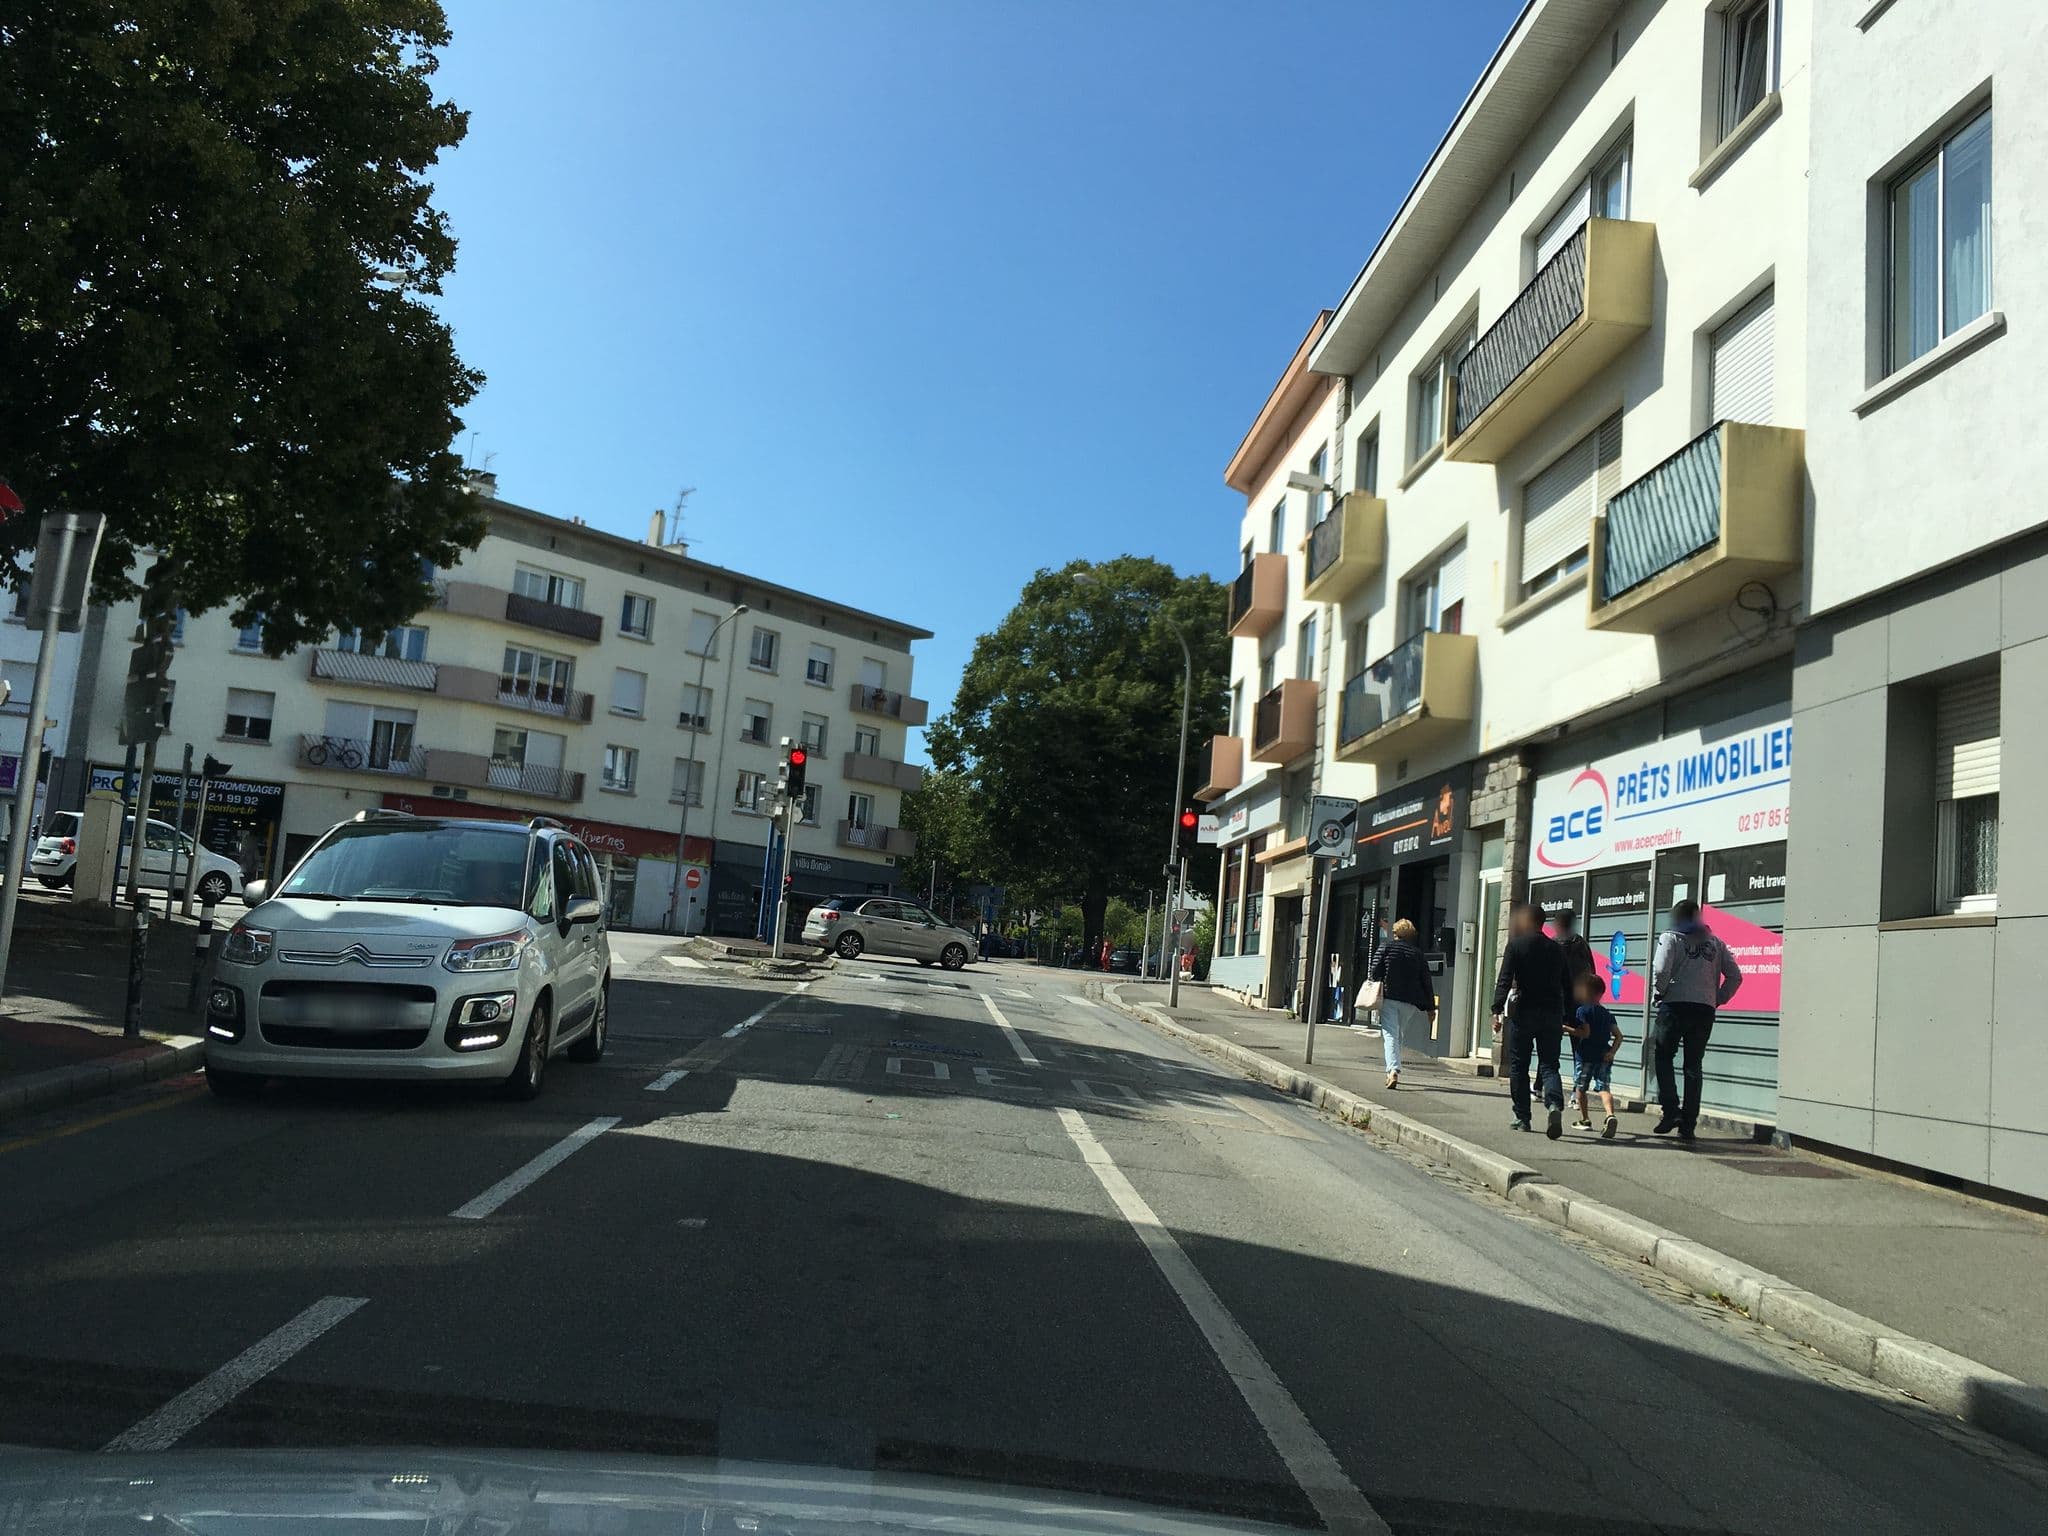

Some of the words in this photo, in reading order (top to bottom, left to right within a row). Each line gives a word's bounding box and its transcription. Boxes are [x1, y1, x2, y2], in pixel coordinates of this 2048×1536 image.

[188, 778, 281, 795] ELCTROMENAGER
[1616, 761, 1670, 808] PRÊTS
[208, 792, 223, 802] 21
[227, 794, 241, 804] 99
[243, 795, 259, 806] 92
[1738, 815, 1750, 833] 02
[1753, 812, 1766, 830] 97
[1768, 809, 1781, 827] 85
[1614, 827, 1682, 853] www.acecredit.fr
[1749, 875, 1765, 889] Prêt
[1597, 895, 1625, 907] Assurance
[1625, 893, 1632, 904] de
[1758, 962, 1781, 973] moins
